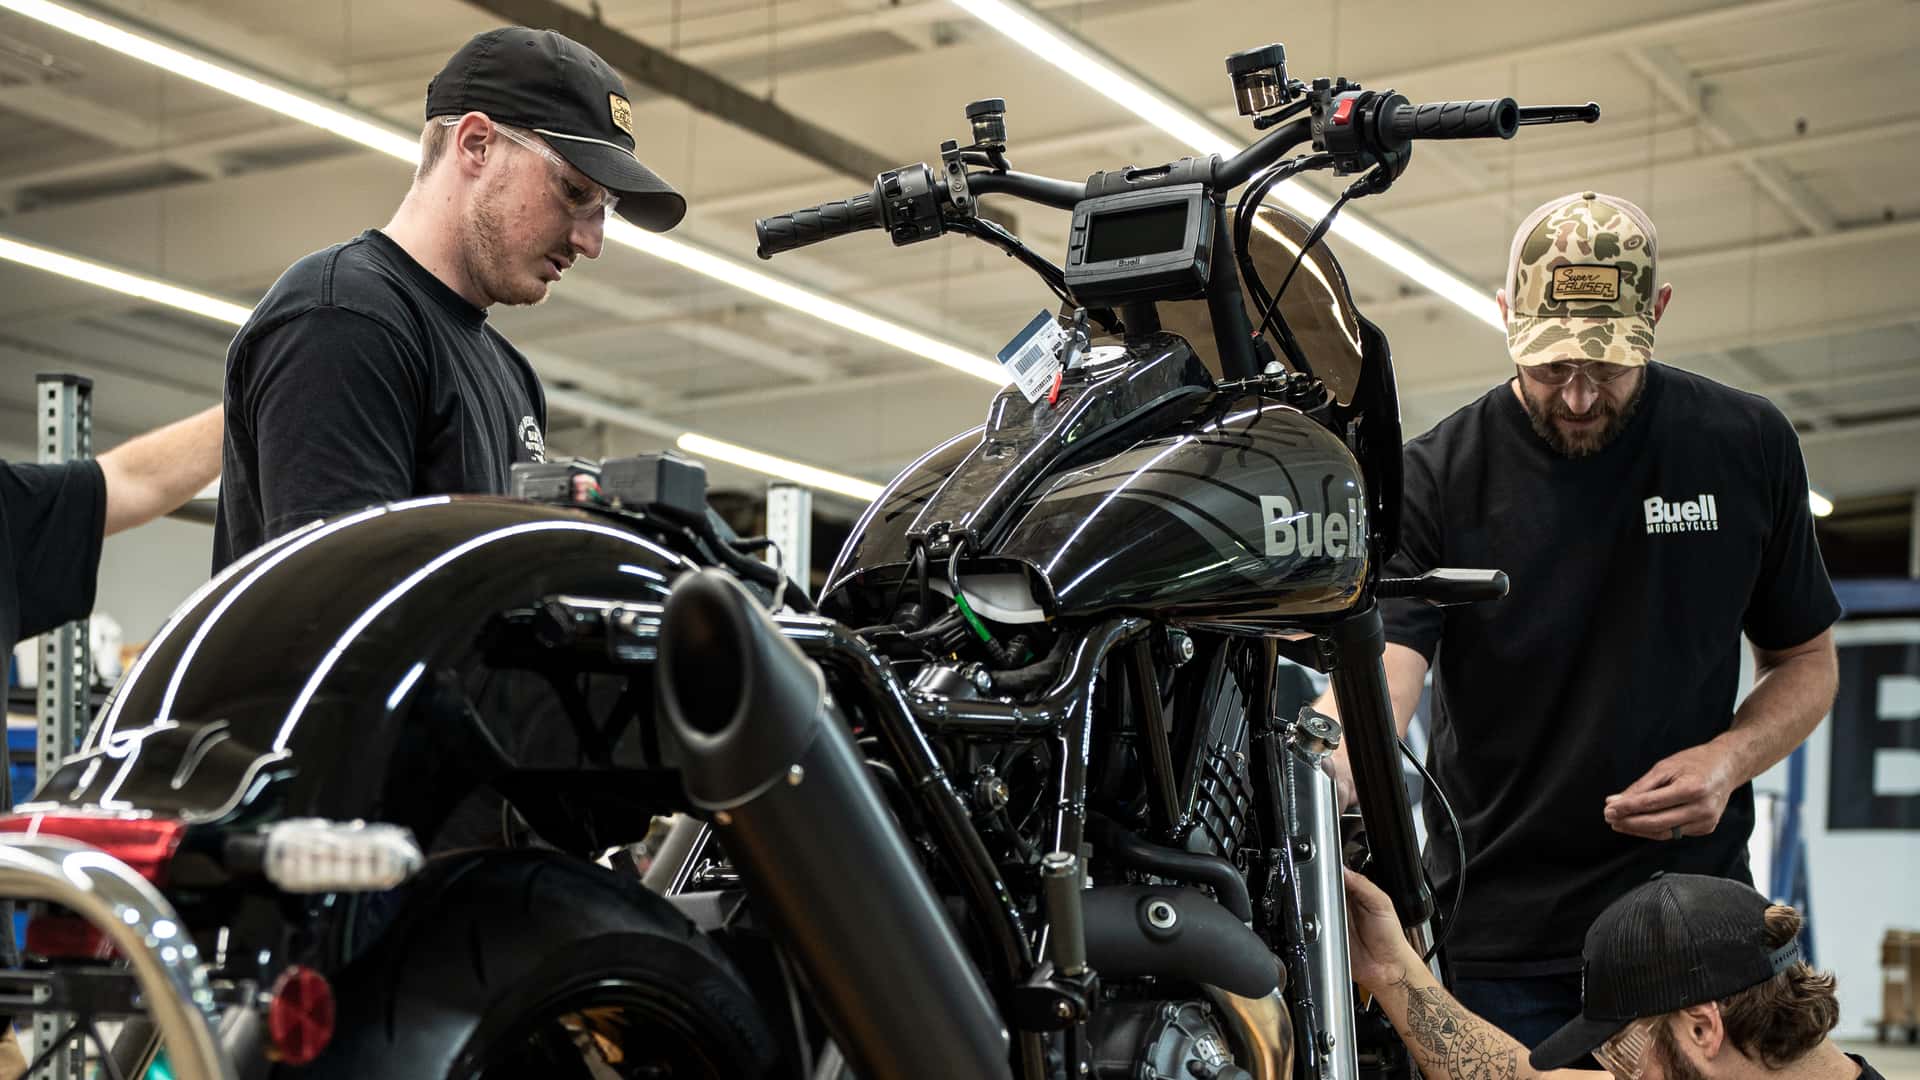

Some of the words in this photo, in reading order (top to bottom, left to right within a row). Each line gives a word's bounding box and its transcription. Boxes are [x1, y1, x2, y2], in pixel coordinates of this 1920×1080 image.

[1563, 269, 1600, 281] Super
[1556, 280, 1615, 293] CRUISER
[1643, 494, 1717, 524] Buell
[1647, 521, 1719, 534] MOTORCYCLES
